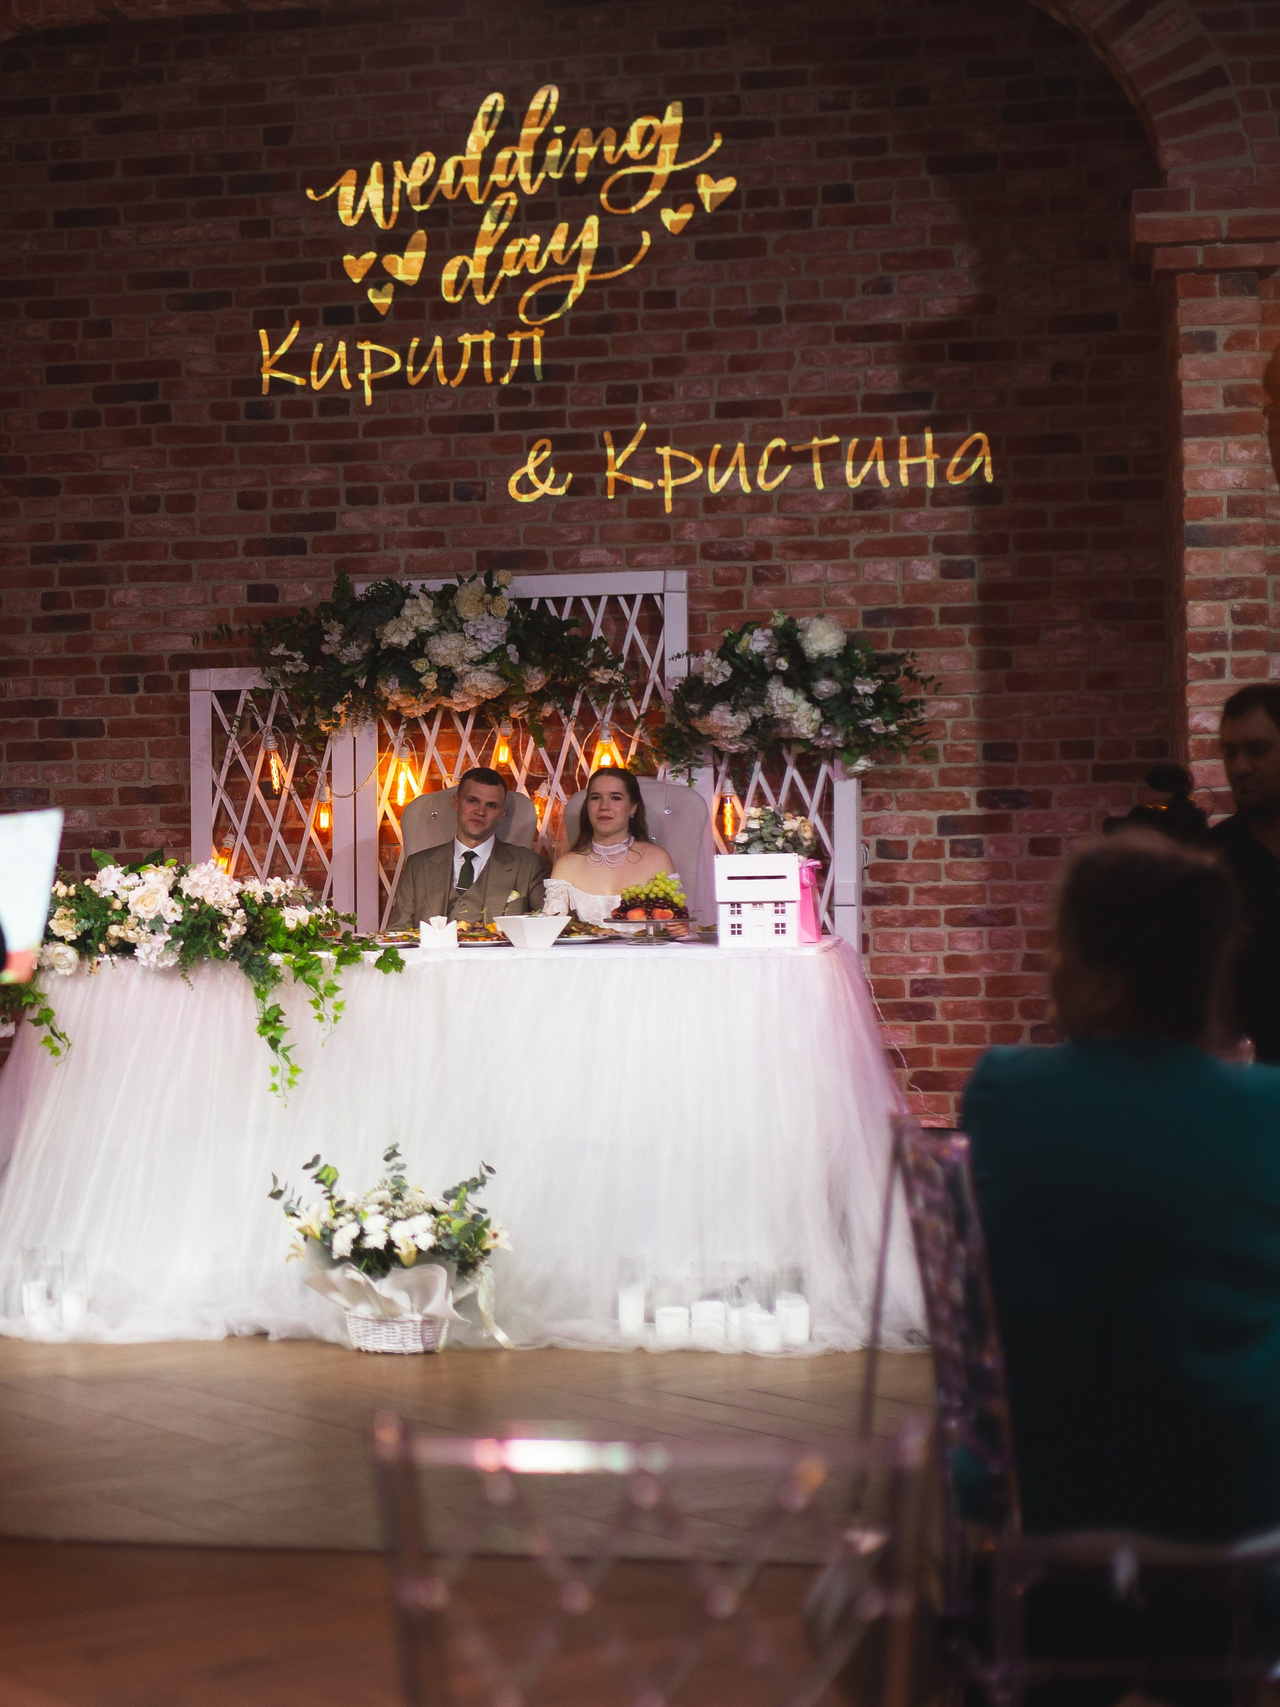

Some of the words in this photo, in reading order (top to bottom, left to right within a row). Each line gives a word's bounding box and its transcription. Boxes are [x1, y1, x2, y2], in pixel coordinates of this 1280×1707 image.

[306, 84, 722, 229] wedding
[441, 192, 651, 325] day
[258, 320, 545, 406] Кирилл
[507, 438, 573, 503] &
[603, 421, 995, 514] Кристина
